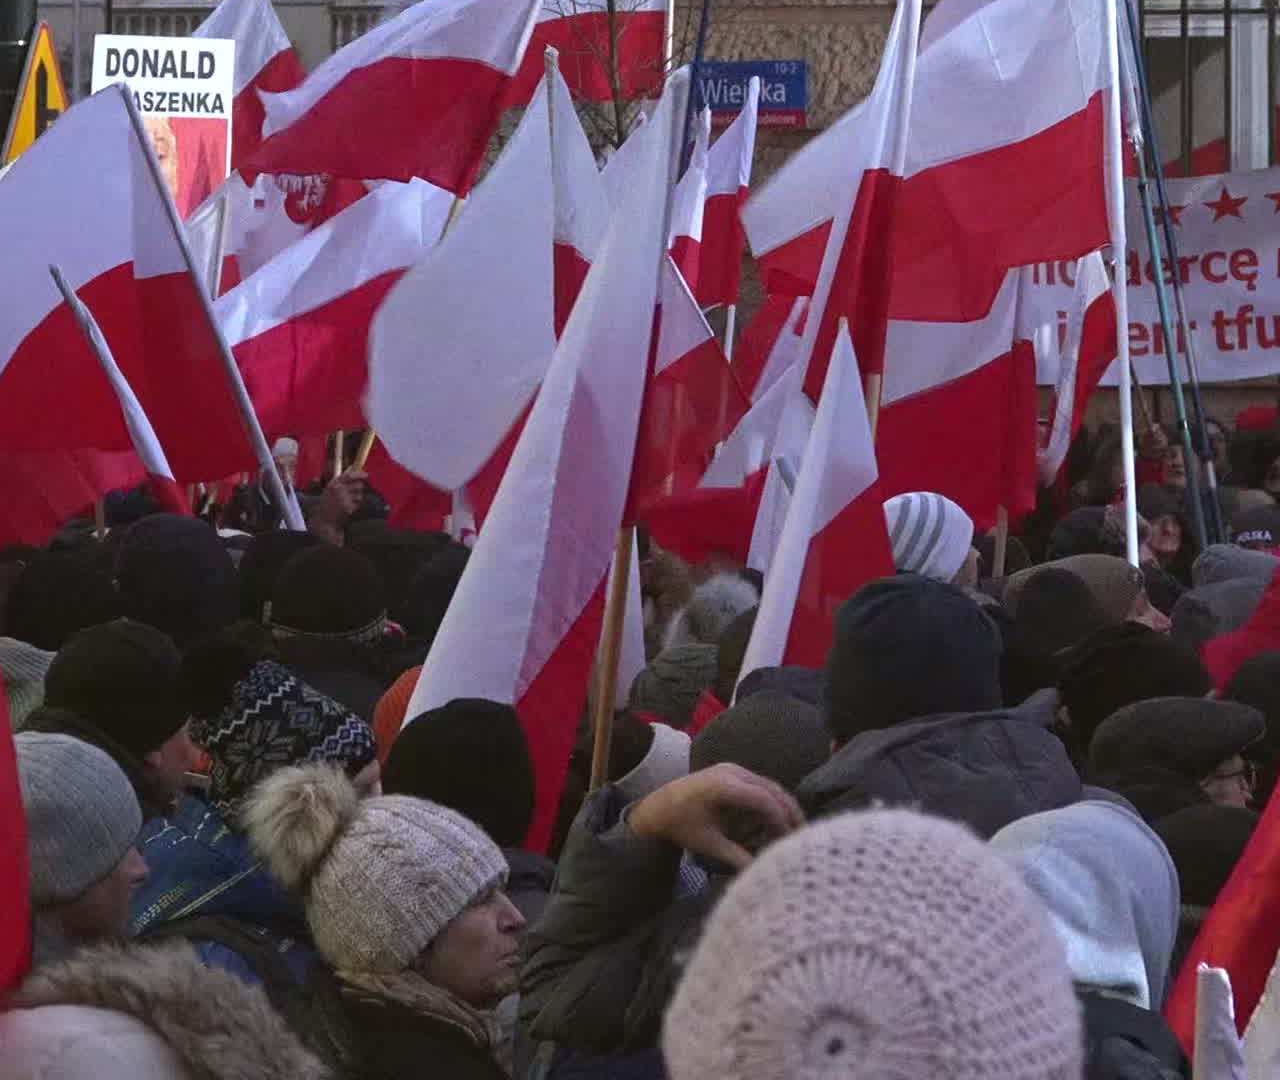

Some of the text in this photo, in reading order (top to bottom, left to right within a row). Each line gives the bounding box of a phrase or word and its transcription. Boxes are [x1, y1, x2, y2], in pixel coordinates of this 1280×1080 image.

[106, 48, 216, 79] DONALD
[133, 91, 225, 113] ASZENKA
[700, 78, 787, 105] Wiejka
